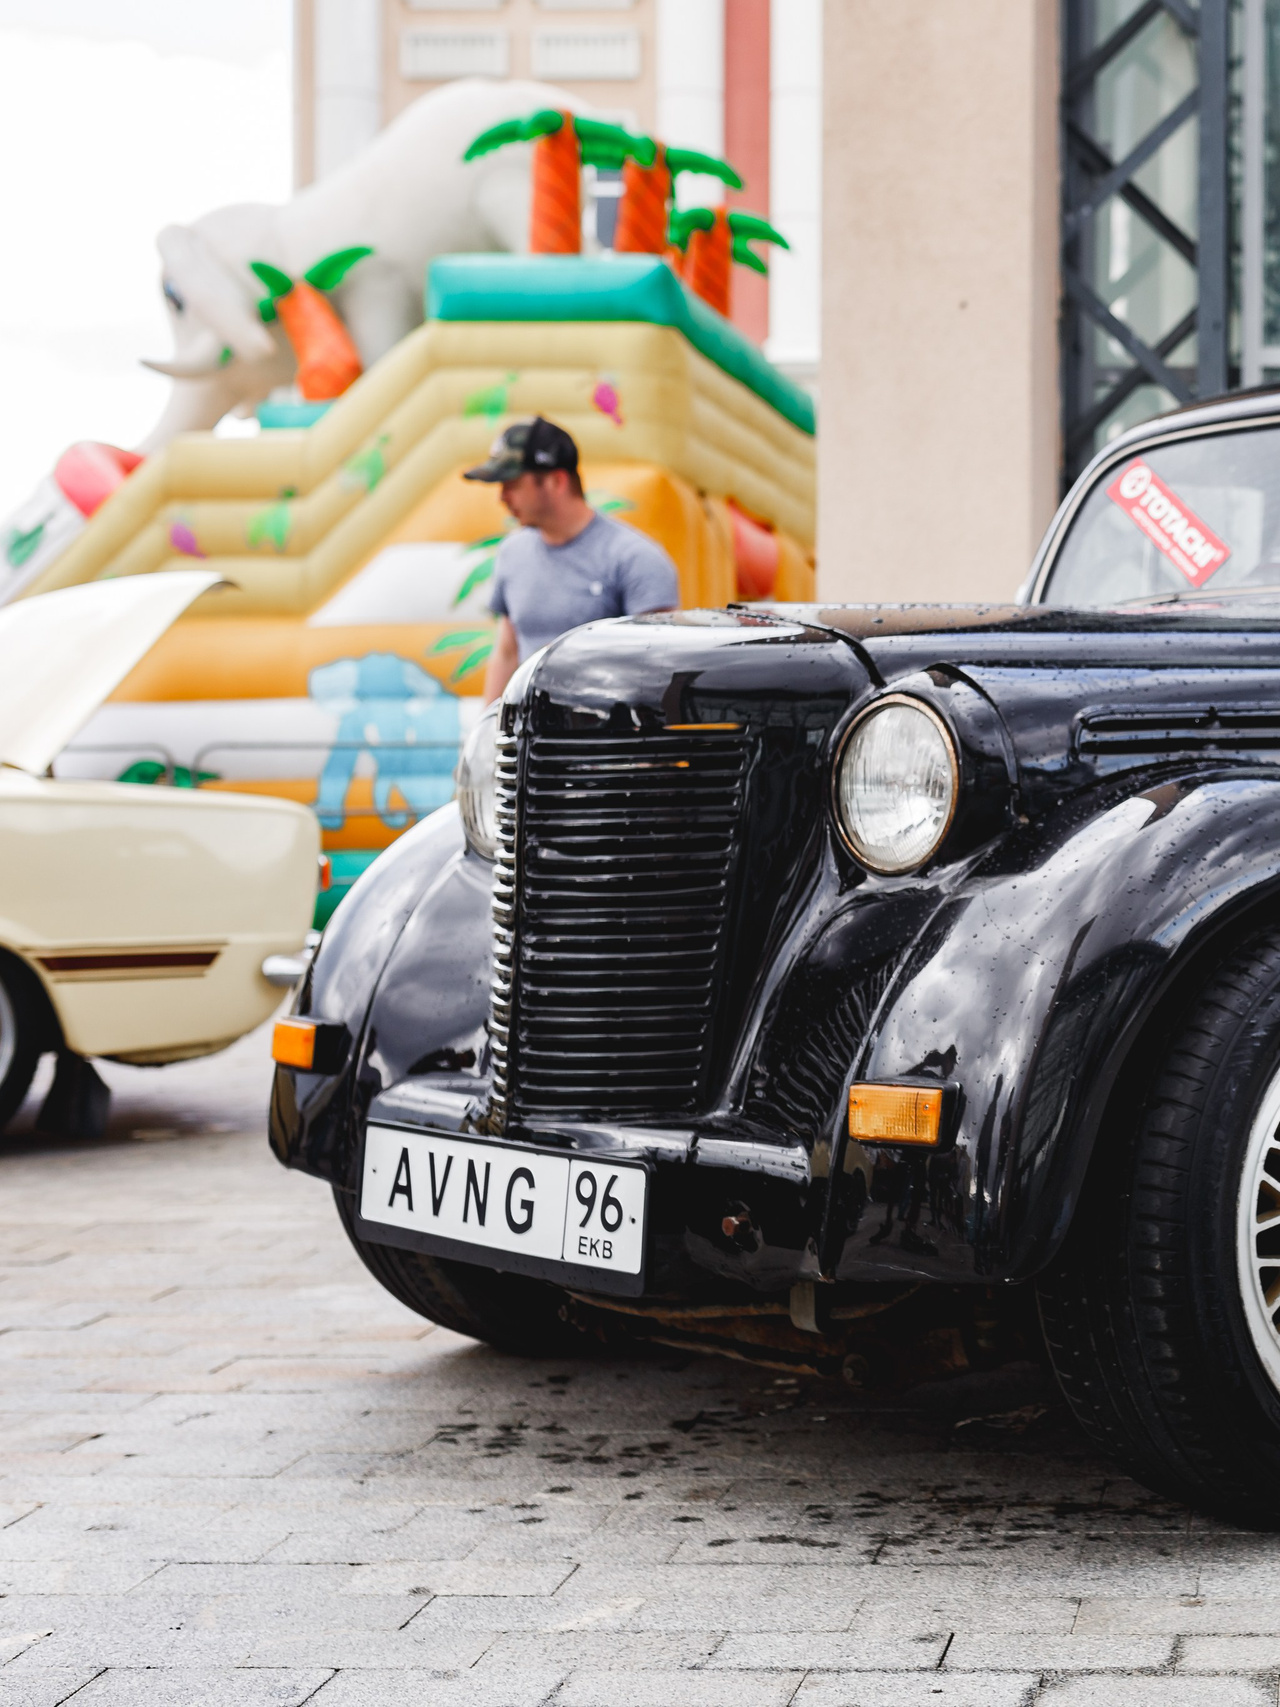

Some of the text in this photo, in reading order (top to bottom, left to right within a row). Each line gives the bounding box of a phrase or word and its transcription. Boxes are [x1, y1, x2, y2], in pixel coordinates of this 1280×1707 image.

[1139, 482, 1216, 568] TOTACHI
[388, 1147, 623, 1234] AVNG 96
[578, 1236, 613, 1259] EKB
